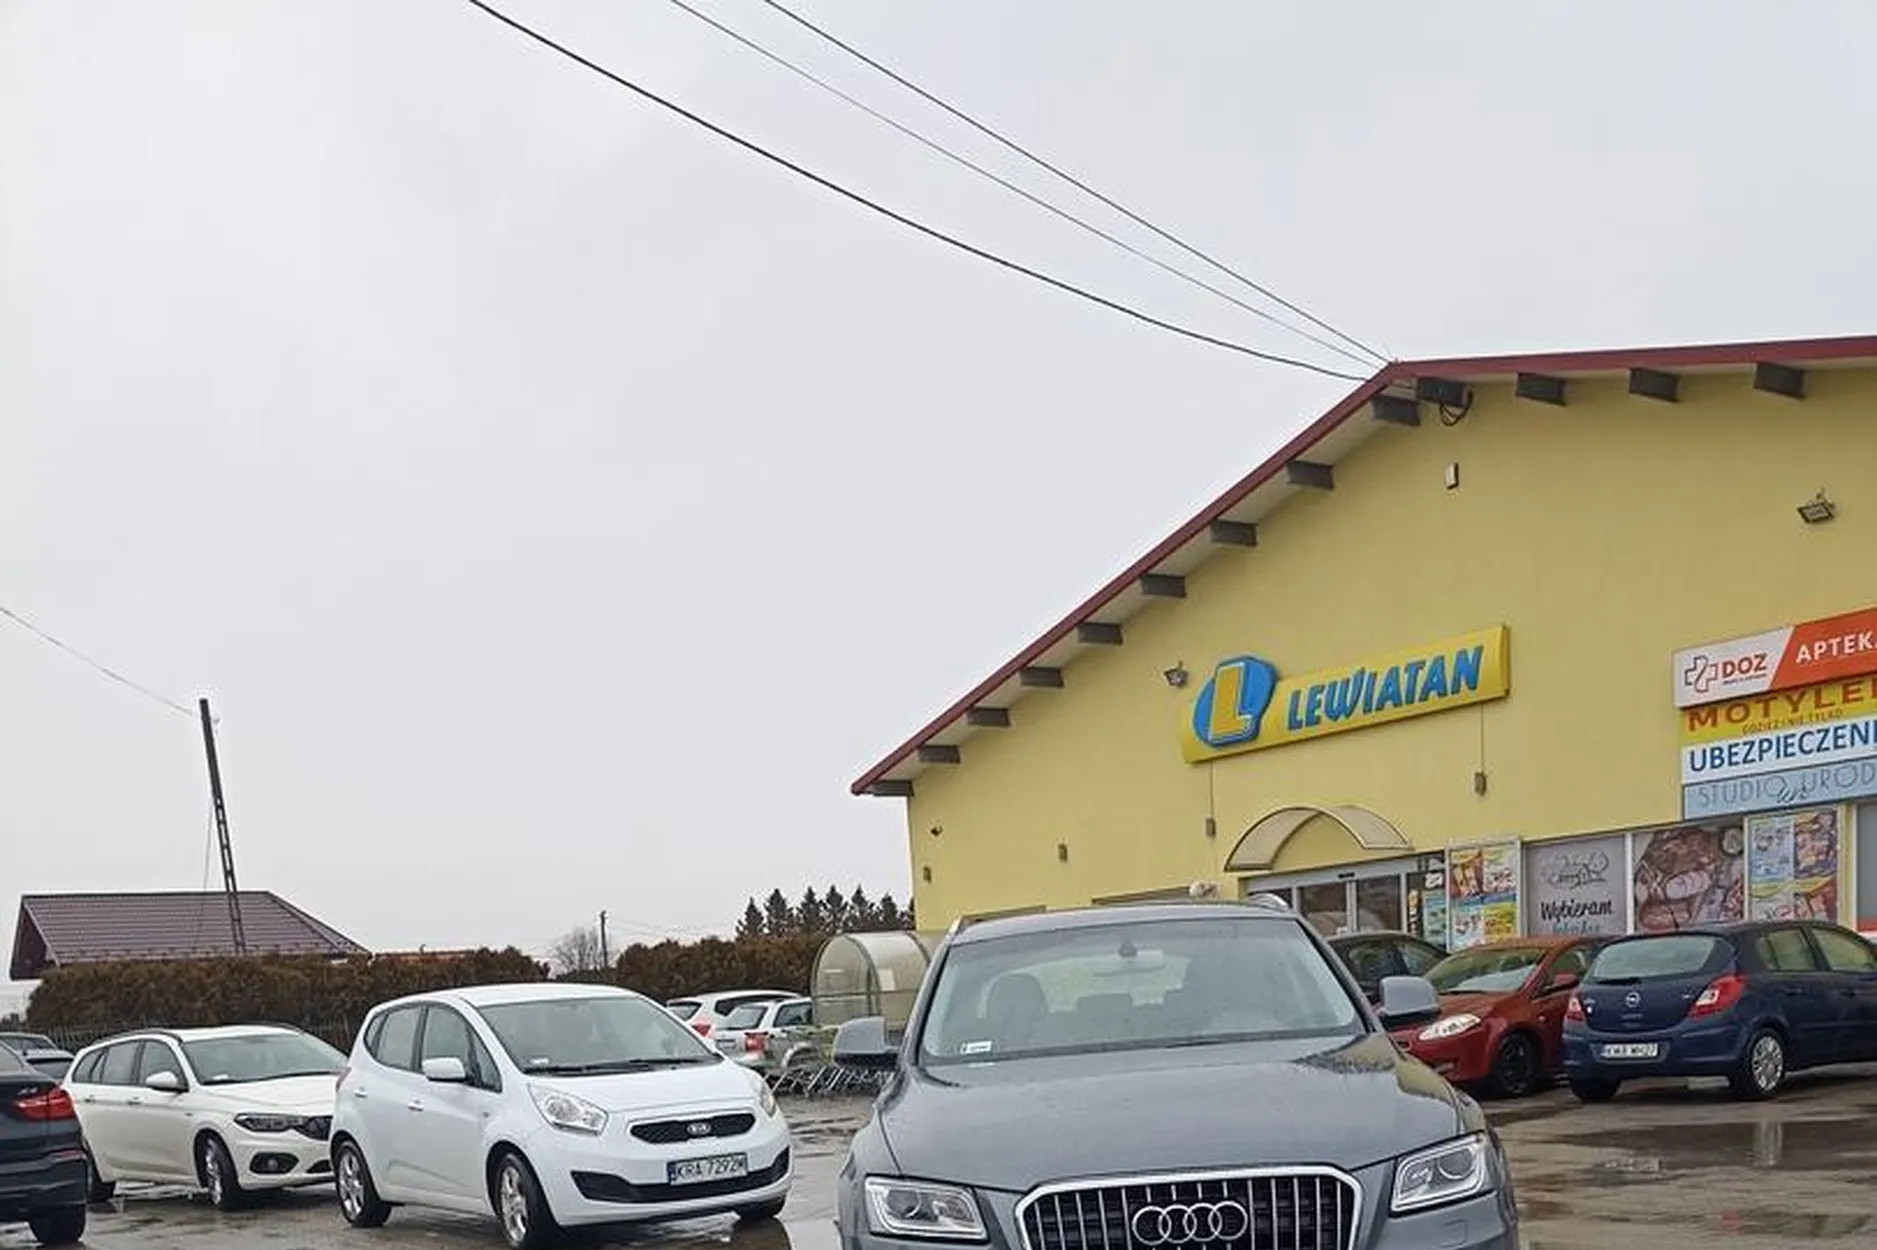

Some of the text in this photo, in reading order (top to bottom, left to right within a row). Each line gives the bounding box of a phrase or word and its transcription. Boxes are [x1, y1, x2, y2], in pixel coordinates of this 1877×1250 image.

[1796, 629, 1877, 664] APTEK
[1721, 653, 1768, 679] DOZ
[1287, 645, 1485, 731] LEWIATAN
[1697, 775, 1788, 808] STUDIO
[1540, 898, 1613, 923] Wybieram
